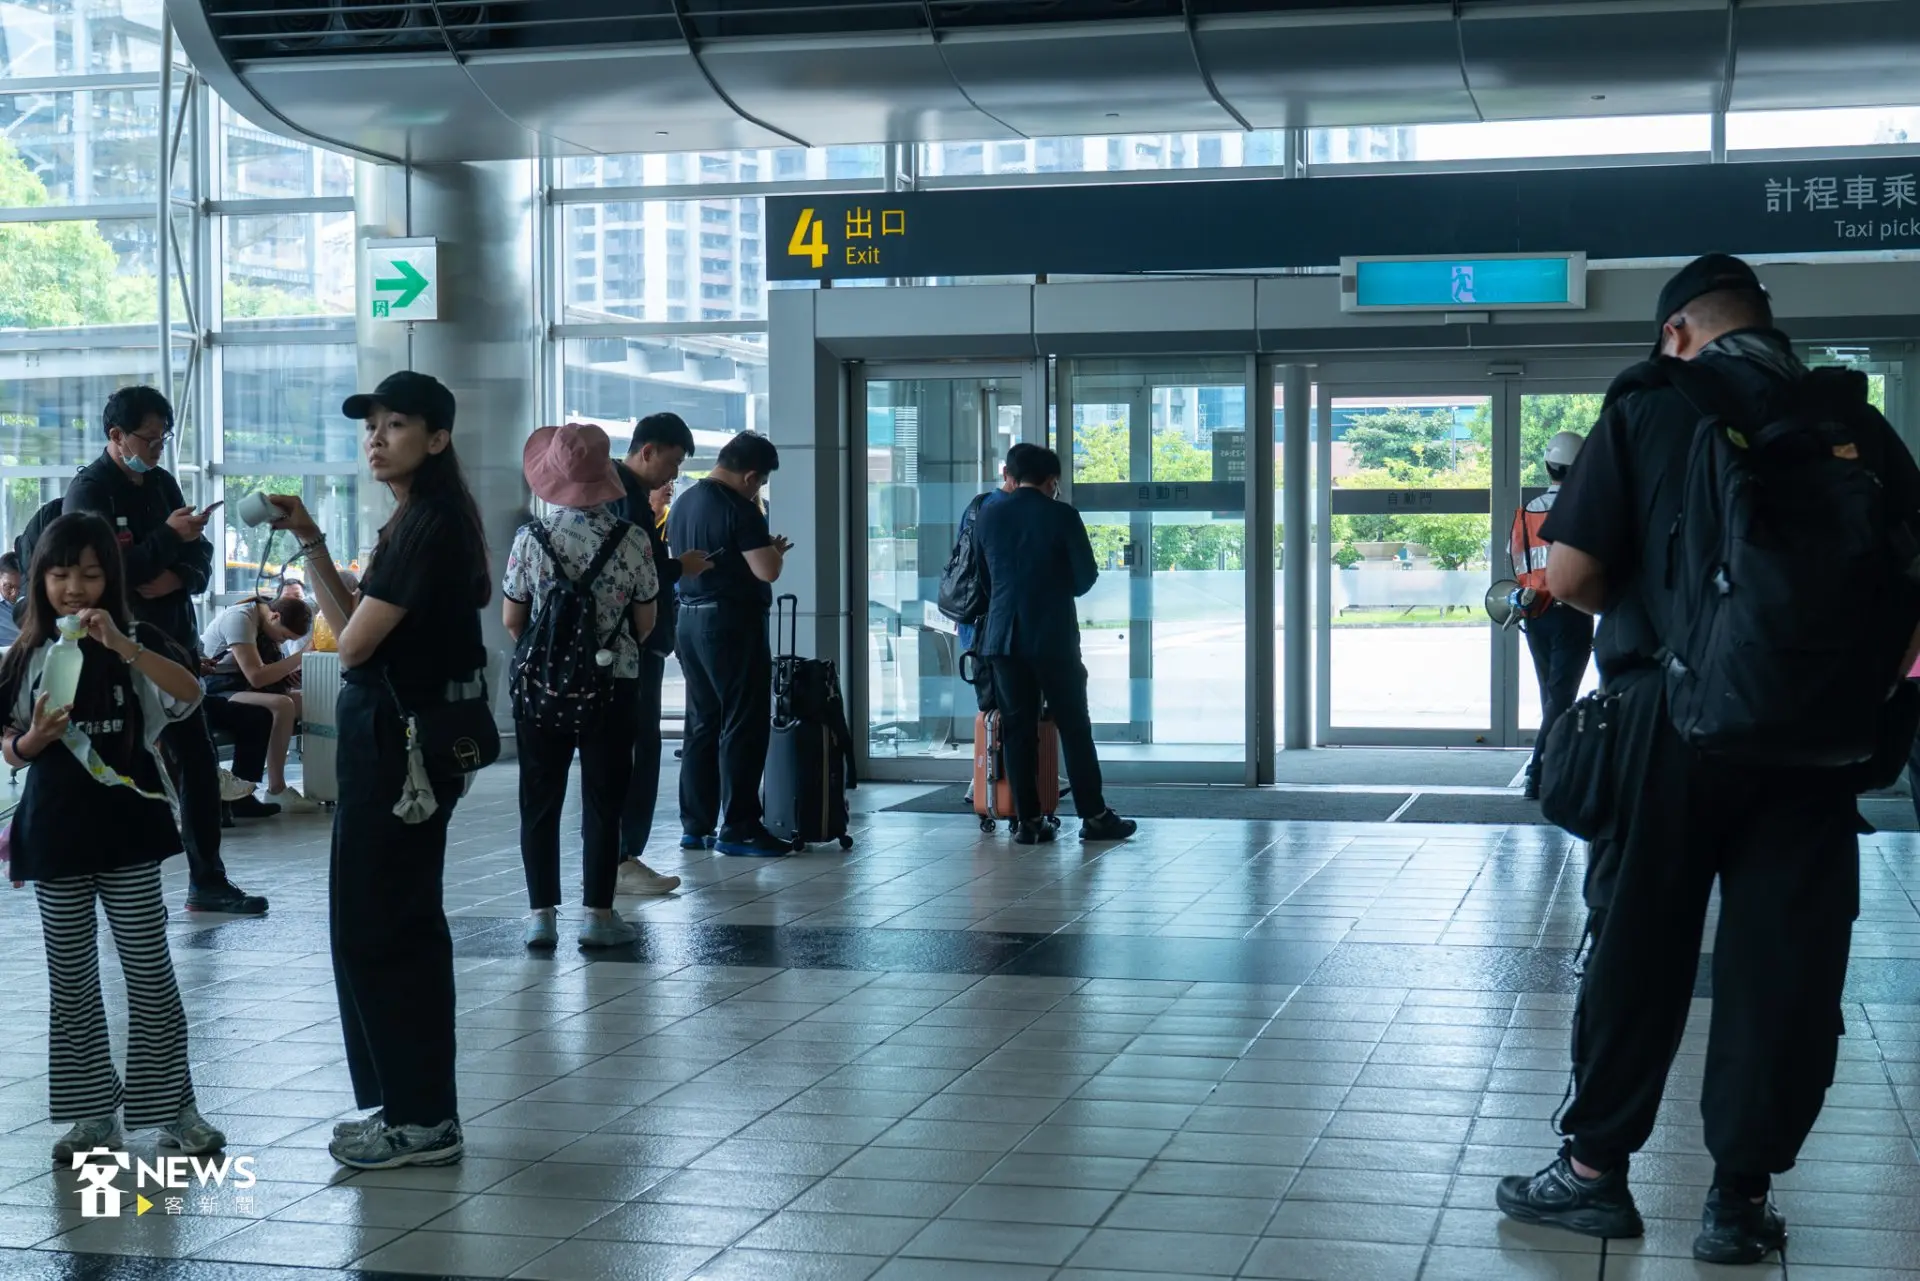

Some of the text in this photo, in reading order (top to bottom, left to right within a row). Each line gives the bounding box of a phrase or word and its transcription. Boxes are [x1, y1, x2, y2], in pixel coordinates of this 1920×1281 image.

[1764, 173, 1918, 212] 計程車乘
[788, 208, 829, 268] 4
[845, 206, 905, 239] 出口
[1834, 218, 1920, 240] Taxi pick
[846, 246, 880, 265] Exit
